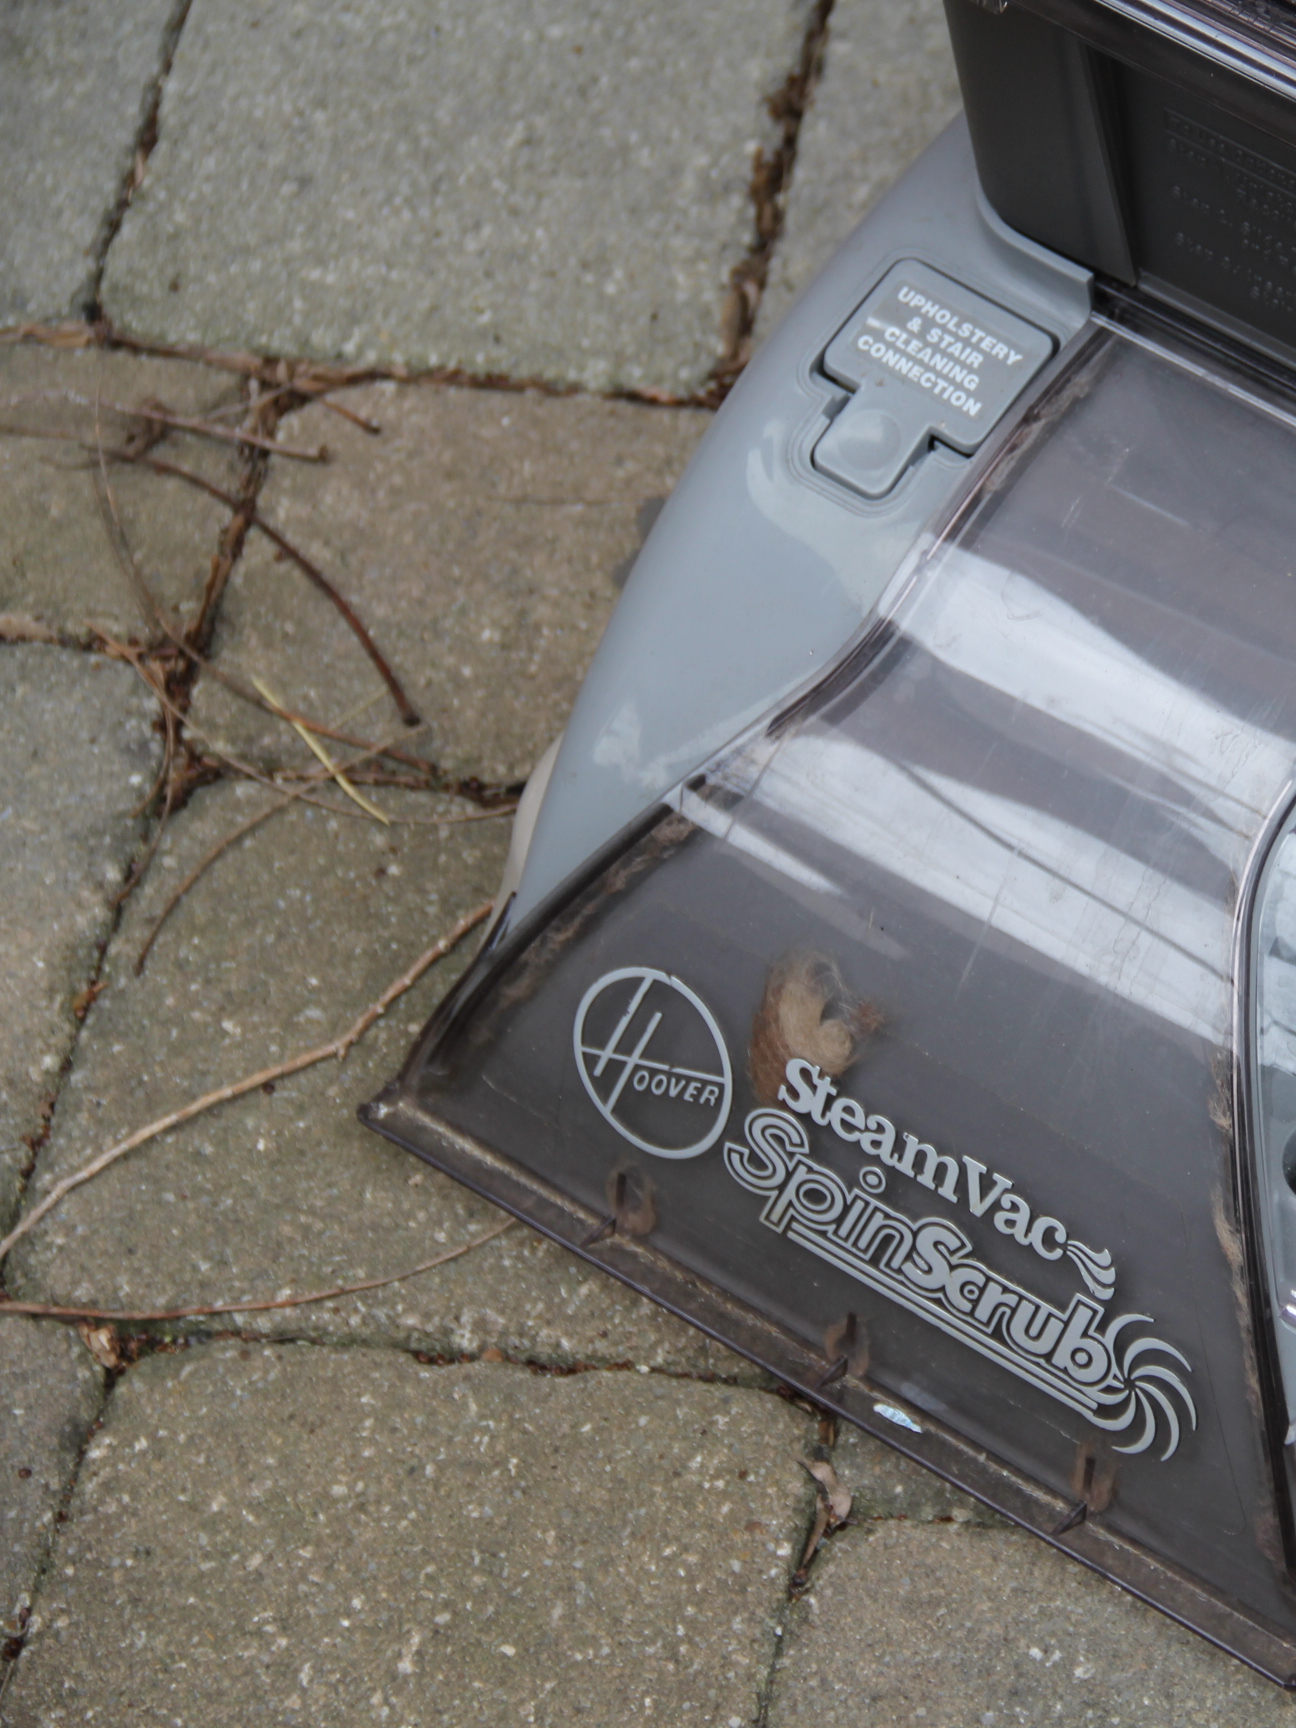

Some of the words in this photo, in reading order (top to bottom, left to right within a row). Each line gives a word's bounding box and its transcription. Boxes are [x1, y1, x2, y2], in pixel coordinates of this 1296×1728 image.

[884, 326, 980, 391] CLEANING
[898, 286, 1023, 366] UPHOLSTERY
[906, 316, 923, 334] &
[926, 327, 984, 369] STAIR
[857, 334, 982, 417] CONNECTION
[778, 1057, 1069, 1261] SteamVac
[724, 1107, 1122, 1401] SpinScrub
